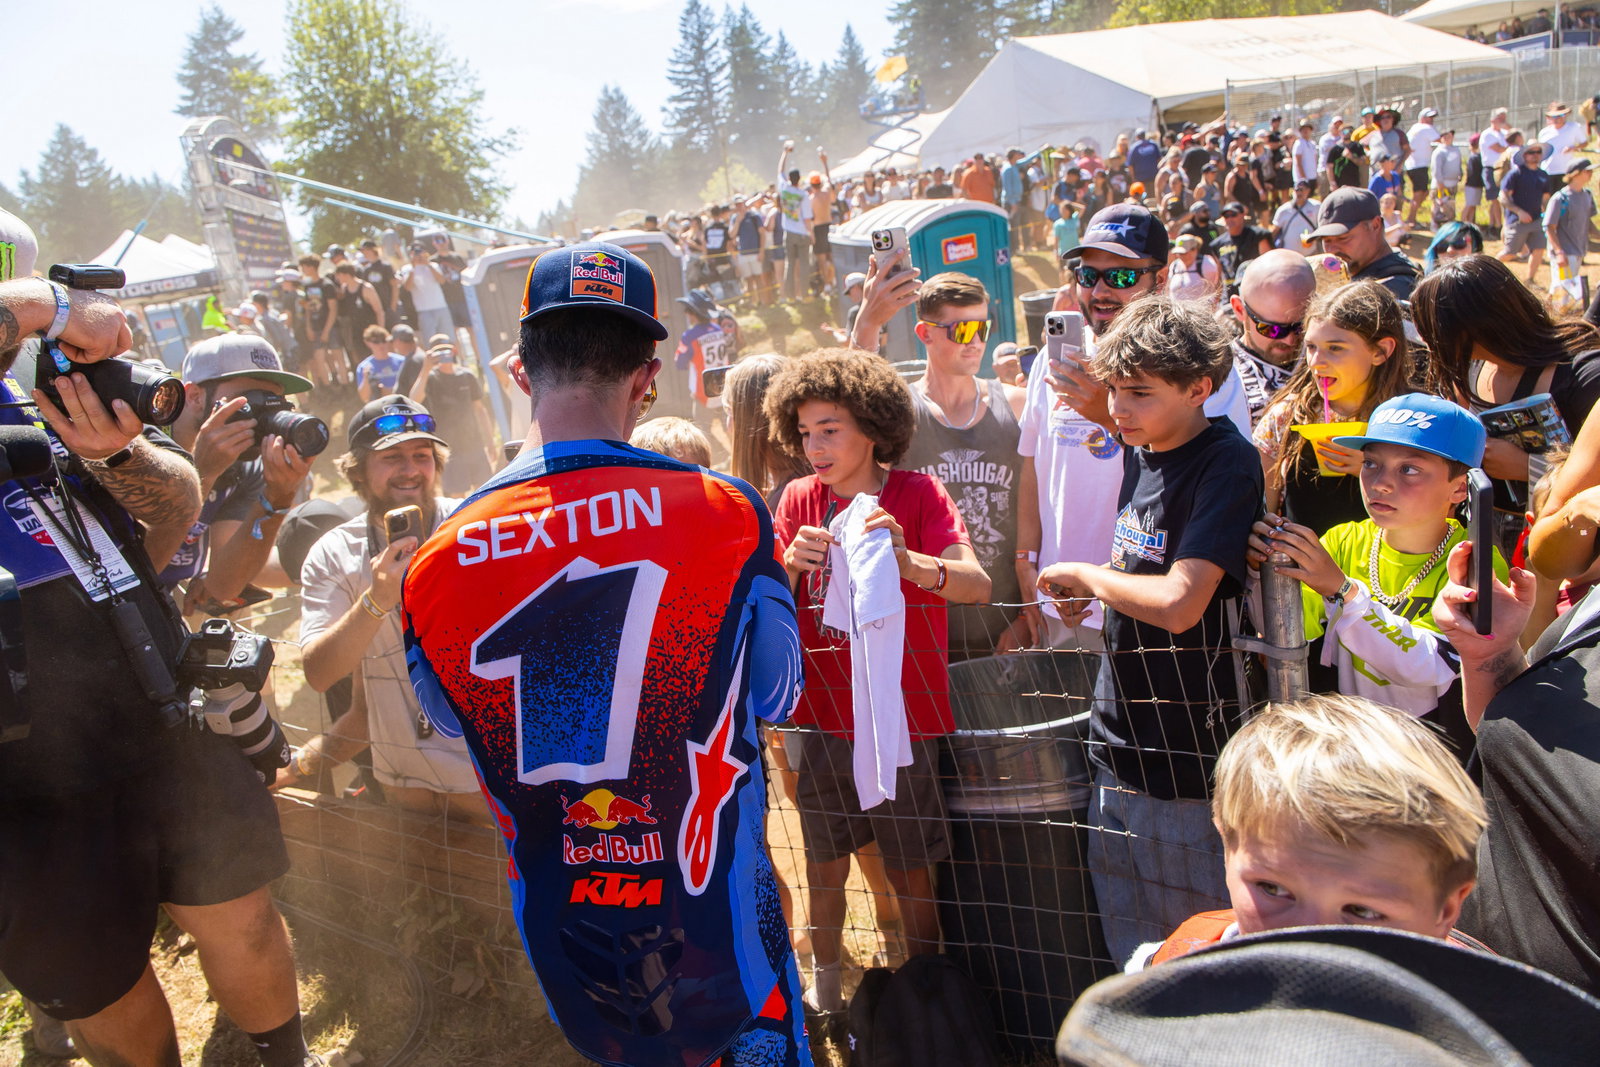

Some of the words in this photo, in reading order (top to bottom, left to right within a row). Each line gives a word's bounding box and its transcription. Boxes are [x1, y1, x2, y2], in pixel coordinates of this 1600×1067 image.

[574, 266, 600, 279] Red
[600, 267, 624, 286] Bull
[584, 283, 614, 296] KTM
[1370, 408, 1438, 429] 100%
[456, 487, 663, 566] SEXTON
[469, 556, 669, 786] 1
[562, 833, 607, 865] Red
[610, 832, 664, 865] Bull
[569, 871, 663, 908] KTM
